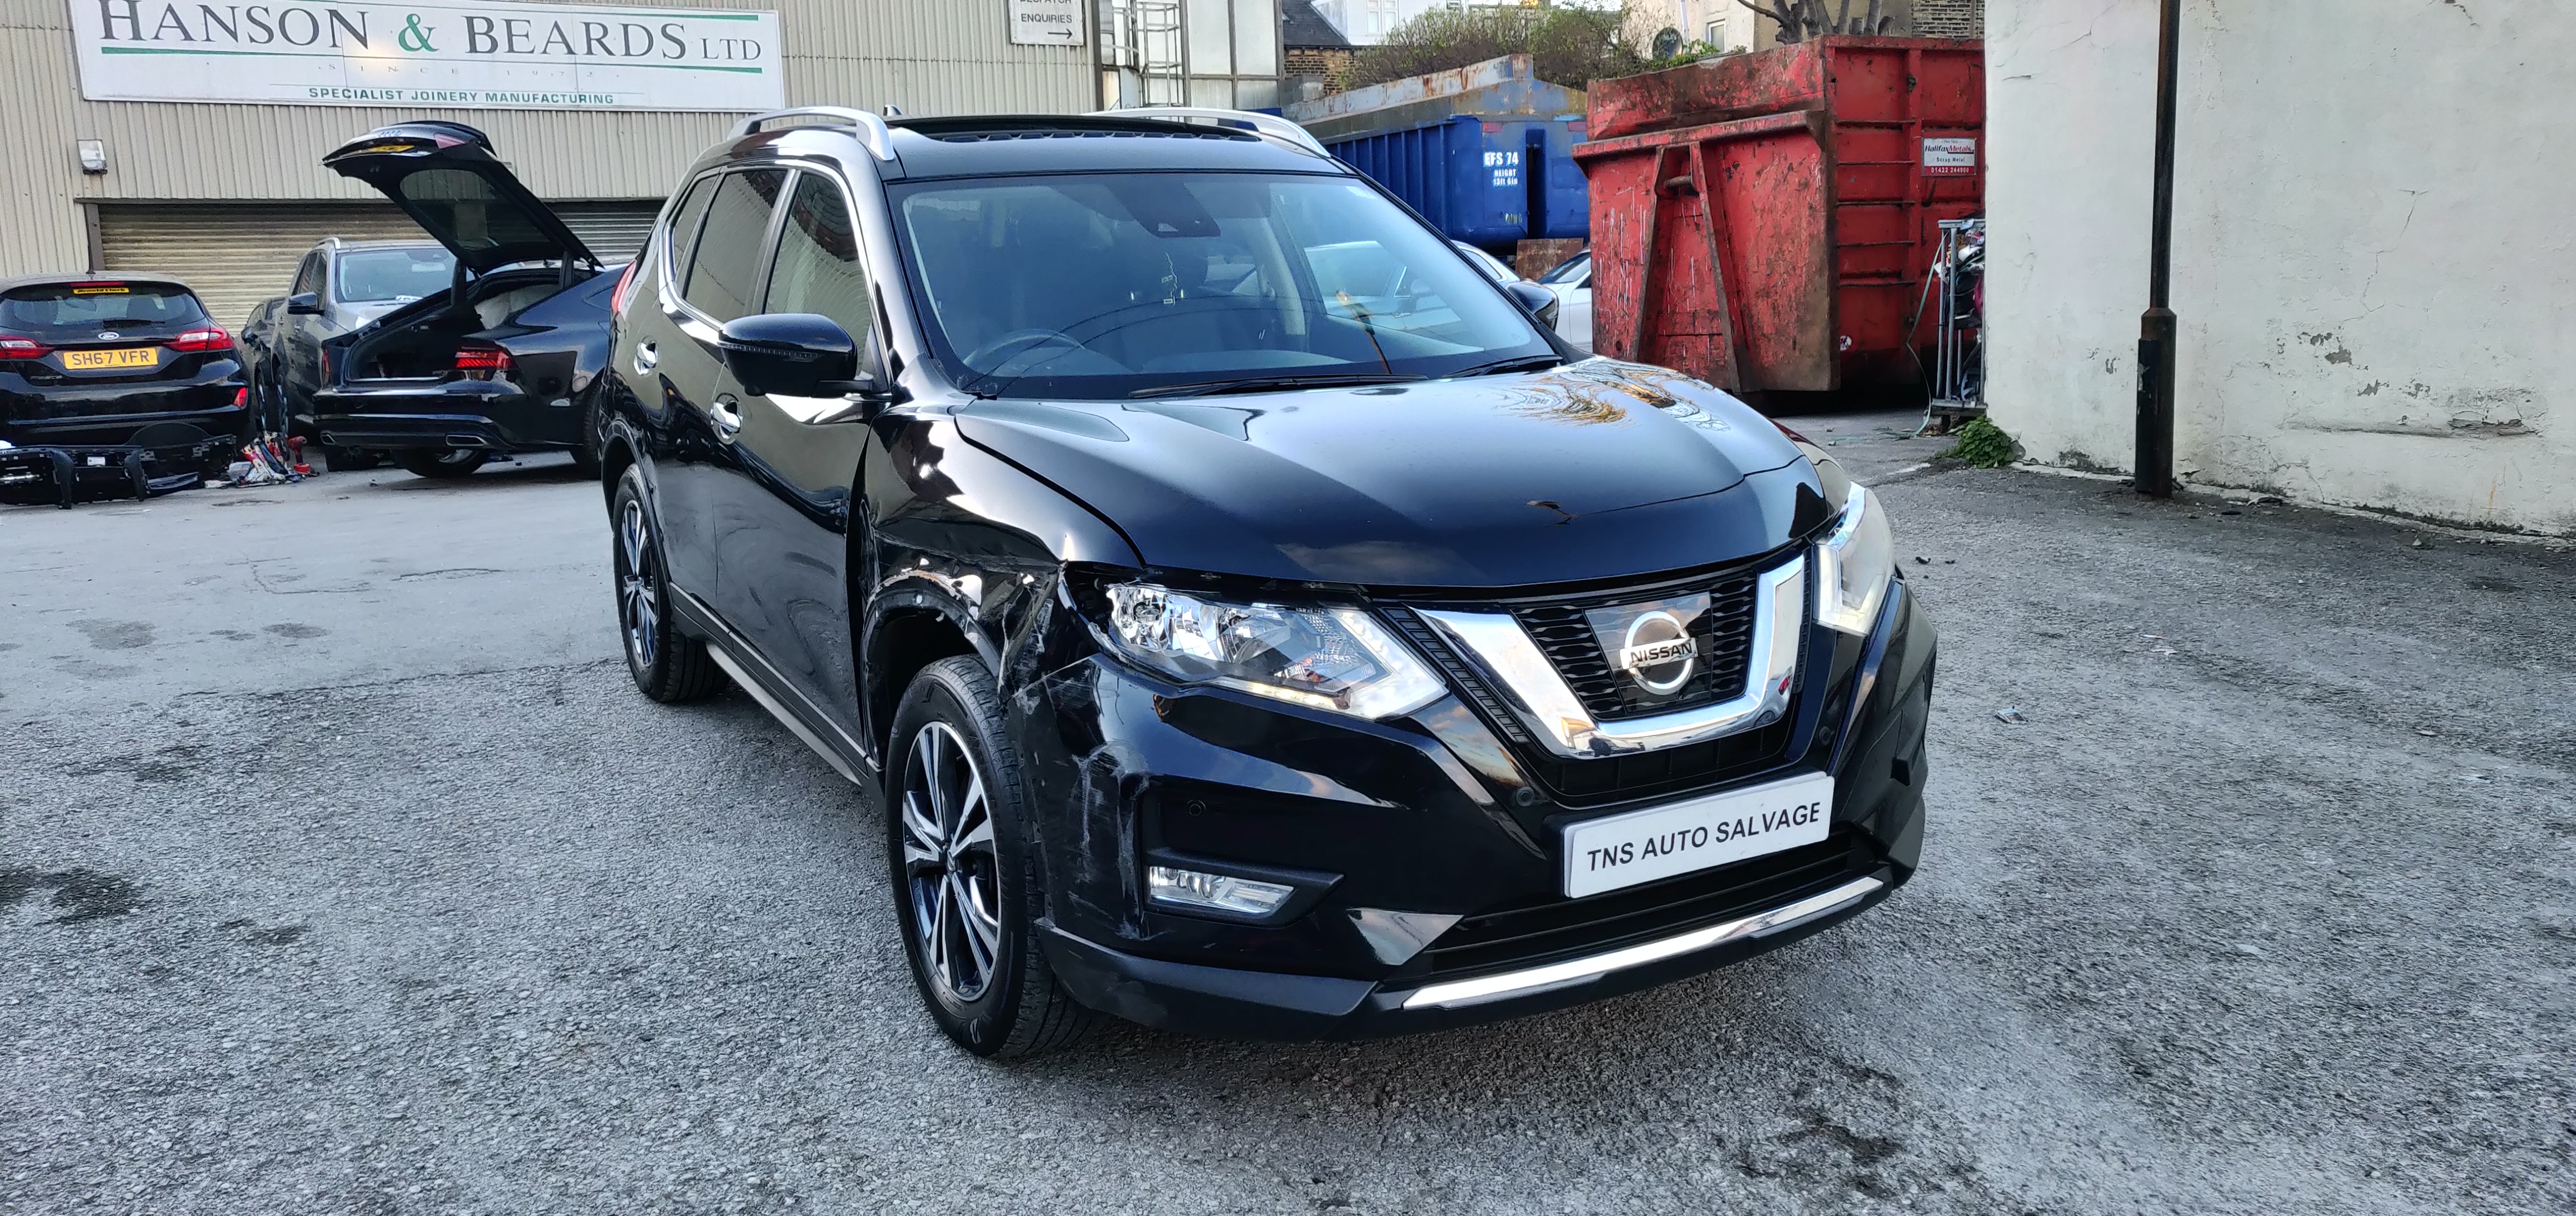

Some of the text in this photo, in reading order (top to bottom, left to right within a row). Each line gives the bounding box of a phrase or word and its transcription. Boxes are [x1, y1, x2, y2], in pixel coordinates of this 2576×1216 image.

[1021, 13, 1072, 23] ENQUIRIES
[100, 0, 761, 60] HANSON & BEARDS LTD
[329, 64, 459, 74] SINCE
[309, 88, 613, 104] SPECIALIST JOINERY MANUFACTURING
[1506, 151, 1519, 165] 74
[1494, 169, 1516, 177] HEIGHT
[72, 350, 150, 365] SH67 VFR
[1630, 642, 1692, 663] NISSAN
[1587, 802, 1821, 871] TNS AUTO SALVAGE
